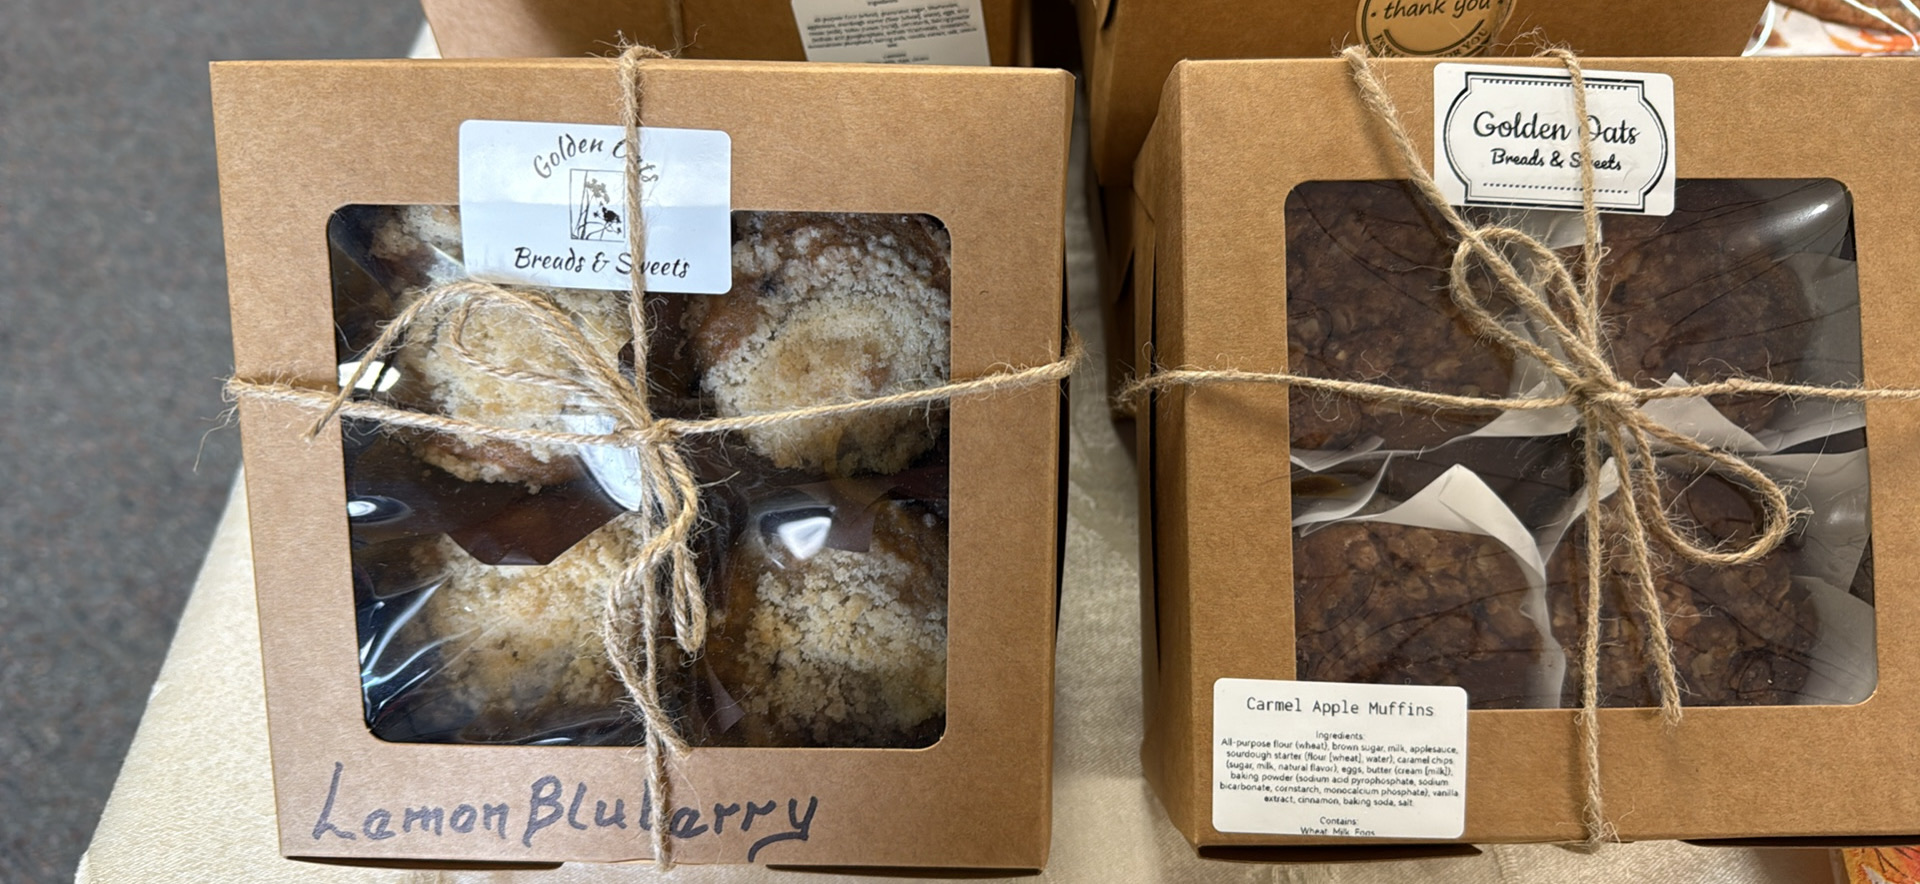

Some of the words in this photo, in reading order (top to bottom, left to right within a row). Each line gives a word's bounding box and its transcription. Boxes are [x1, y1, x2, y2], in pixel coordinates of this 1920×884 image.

[1384, 0, 1445, 20] thank
[1452, 0, 1491, 19] you
[1473, 111, 1572, 142] Golden
[1578, 114, 1641, 145] Oats
[533, 134, 604, 179] Golden
[612, 138, 660, 183] Ots
[1491, 148, 1545, 167] Breads
[1550, 151, 1565, 169] &
[1569, 151, 1622, 171] Seets
[514, 246, 586, 273] Breads
[592, 251, 610, 274] &
[1246, 696, 1302, 713] Carmel
[1312, 699, 1359, 717] Apple
[1368, 701, 1435, 717] Muffins
[1220, 738, 1271, 749] All-purpose
[1273, 740, 1292, 749] flour
[1331, 742, 1359, 751] brown
[1226, 751, 1272, 762] sourdough
[1274, 752, 1302, 761] starter
[1304, 752, 1327, 762] (flour
[1397, 755, 1430, 764] caramel
[1278, 763, 1308, 772] natural
[1366, 766, 1392, 774] butter
[1394, 767, 1423, 775] (cream
[1230, 771, 1259, 782] baking
[1261, 773, 1293, 783] powder
[1295, 773, 1330, 783] (sodium
[1331, 775, 1350, 784] acid
[1418, 778, 1449, 786] sodium
[1323, 785, 1379, 795] monocalcium
[1432, 789, 1460, 797] vanilla
[1343, 797, 1371, 807] baking
